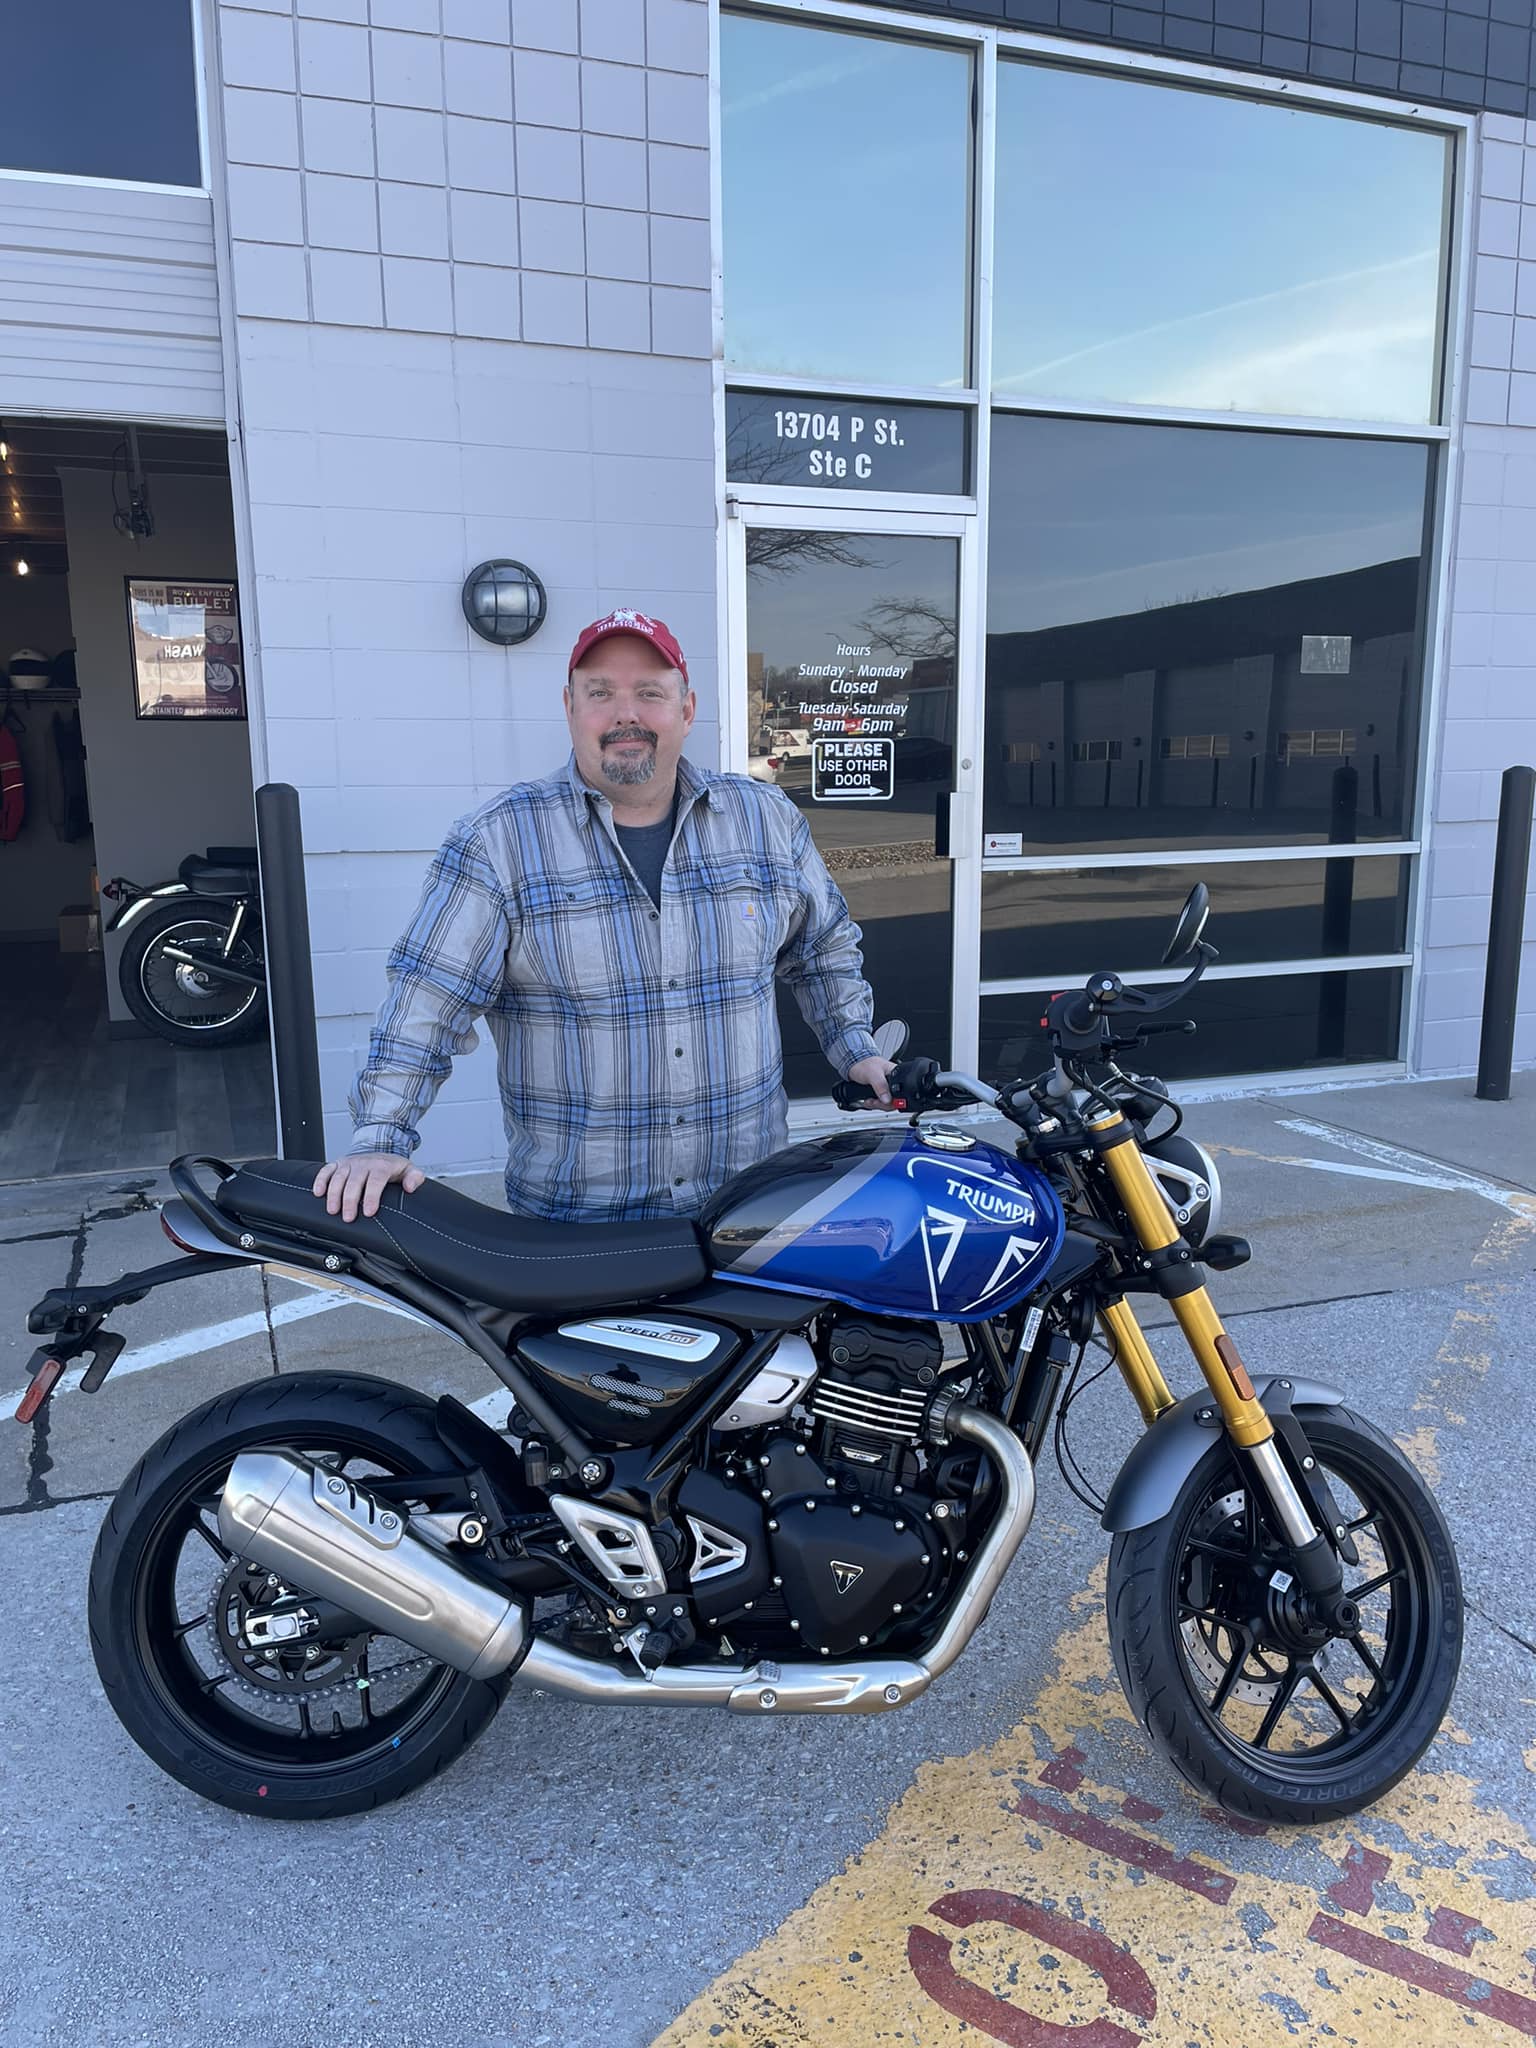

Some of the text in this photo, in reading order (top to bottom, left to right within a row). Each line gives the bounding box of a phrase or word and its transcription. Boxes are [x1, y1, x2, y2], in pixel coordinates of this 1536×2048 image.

[775, 411, 905, 446] 13704 P St.
[809, 449, 872, 478] Ste C
[174, 597, 231, 609] BULLET
[836, 644, 871, 656] Hours
[798, 664, 846, 678] Sunday
[857, 665, 908, 679] Monday
[830, 680, 878, 694] Closed
[799, 702, 908, 717] Tuesday-Saturday
[813, 718, 846, 732] 9am
[862, 718, 894, 734] 6pm
[824, 743, 883, 757] PLEASE
[818, 760, 888, 771] USE OTHER
[835, 774, 871, 785] DOOR
[946, 1178, 1035, 1227] TRIUMPH
[616, 1324, 691, 1344] SPEED 400
[1266, 1772, 1378, 1800] SPORTEC
